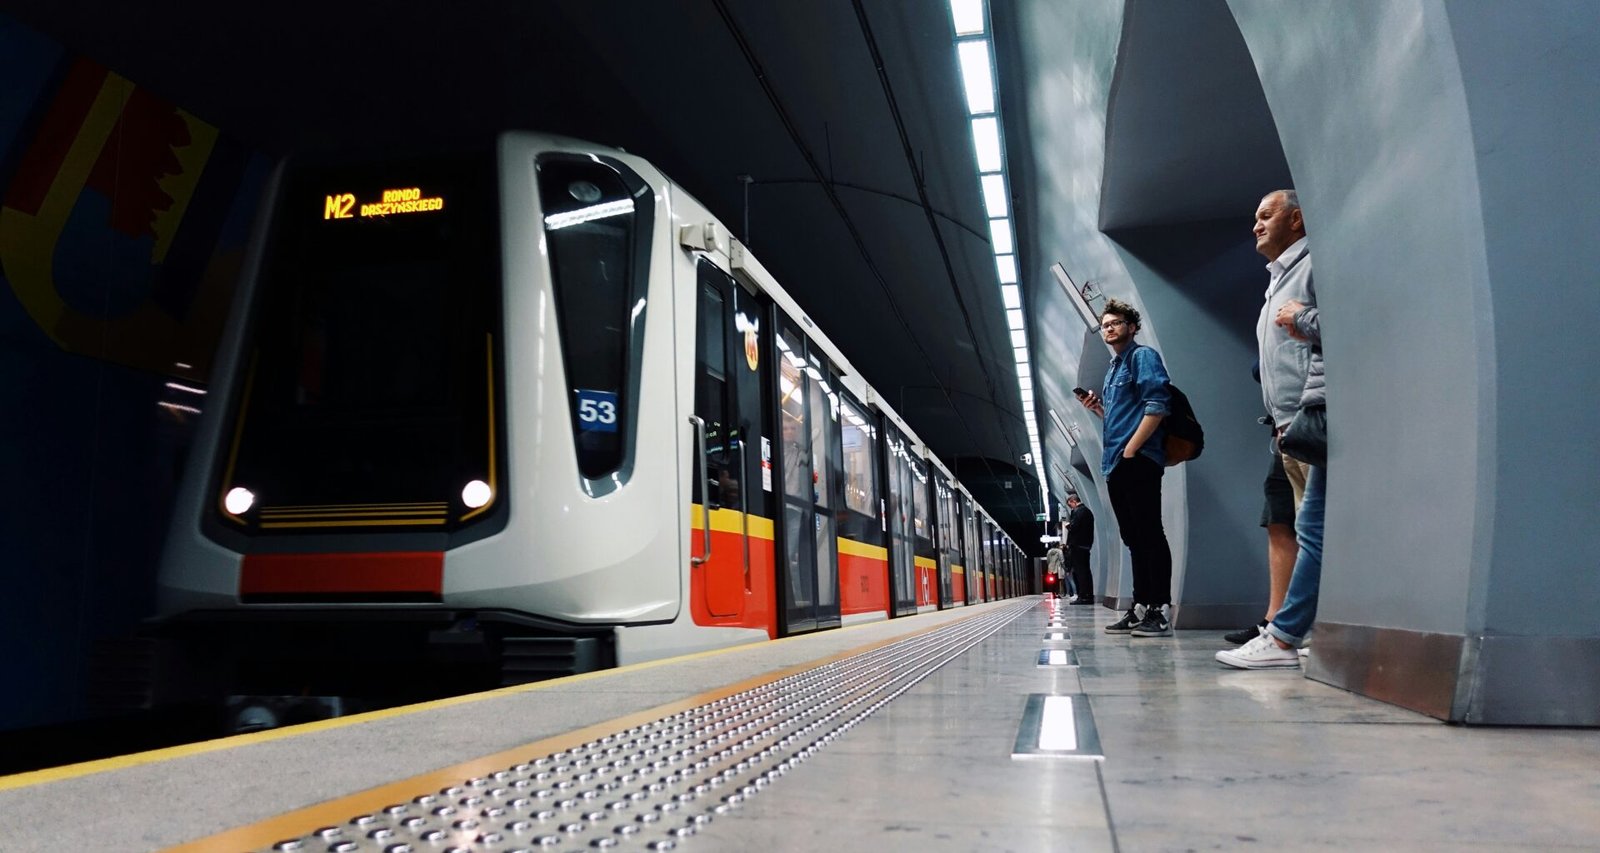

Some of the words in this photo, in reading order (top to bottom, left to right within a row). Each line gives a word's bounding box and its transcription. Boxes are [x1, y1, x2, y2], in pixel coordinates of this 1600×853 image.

[324, 193, 356, 219] M2
[383, 187, 421, 203] RONDO
[579, 398, 616, 424] 53
